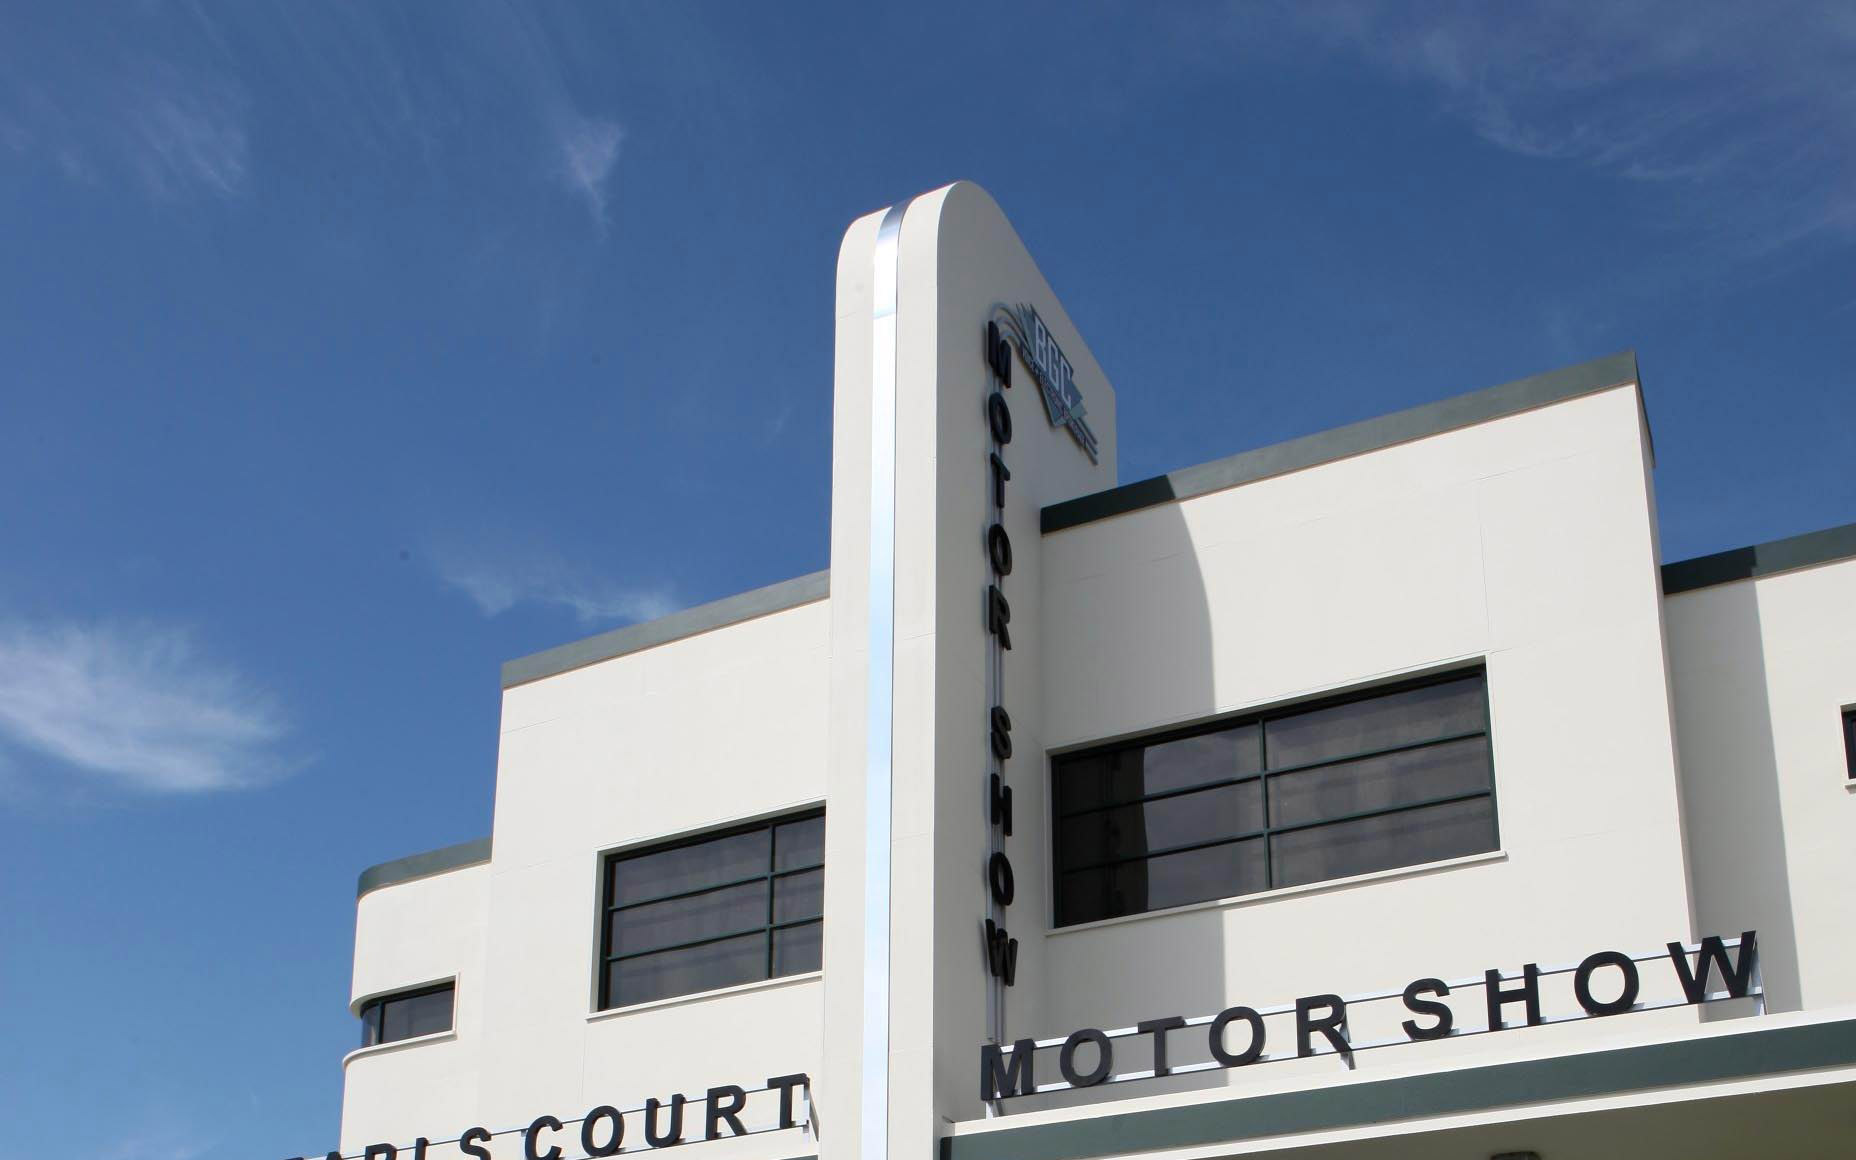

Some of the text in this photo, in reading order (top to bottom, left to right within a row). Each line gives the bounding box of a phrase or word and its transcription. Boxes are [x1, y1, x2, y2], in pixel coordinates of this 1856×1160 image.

[1034, 315, 1072, 410] BGC
[986, 320, 1018, 986] MOTOR SHOW
[981, 930, 1757, 1100] MOTOR SHOW
